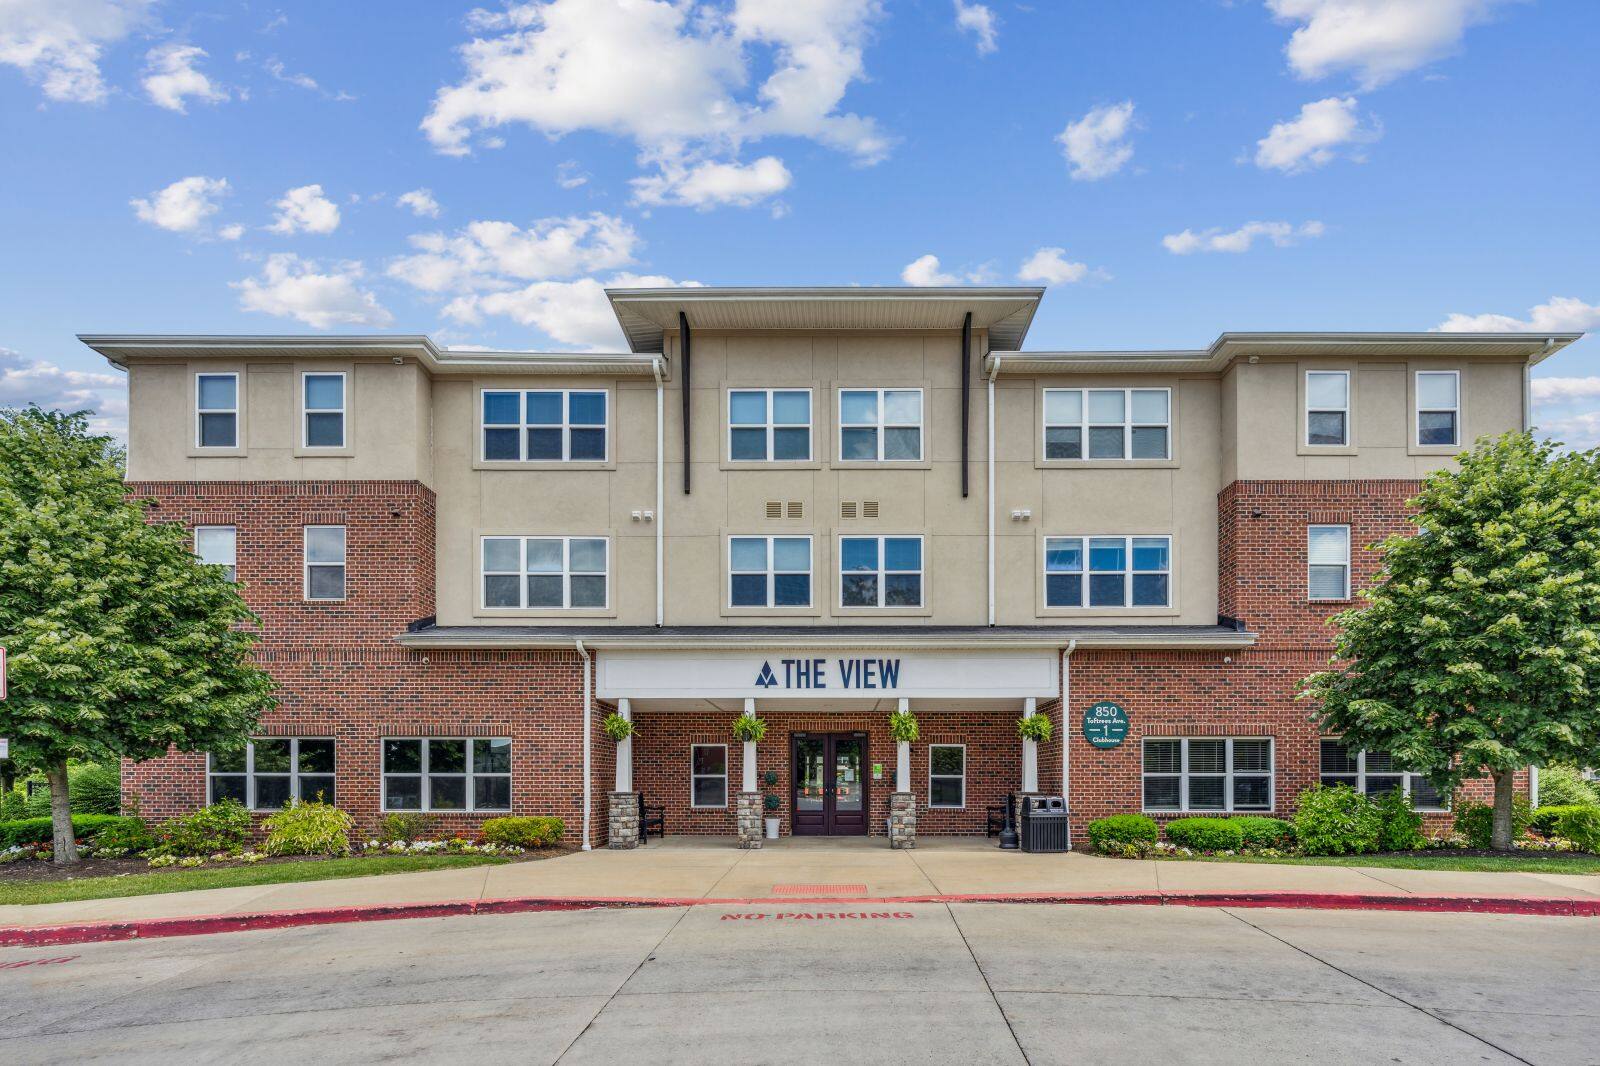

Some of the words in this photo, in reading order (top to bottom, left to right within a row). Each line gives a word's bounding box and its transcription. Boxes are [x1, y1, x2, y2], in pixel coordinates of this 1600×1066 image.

[781, 659, 826, 689] THE
[838, 659, 901, 689] VIEW
[1095, 706, 1118, 717] 850
[1103, 724, 1108, 737] 1
[720, 913, 766, 921] NO
[775, 912, 915, 920] PARKING
